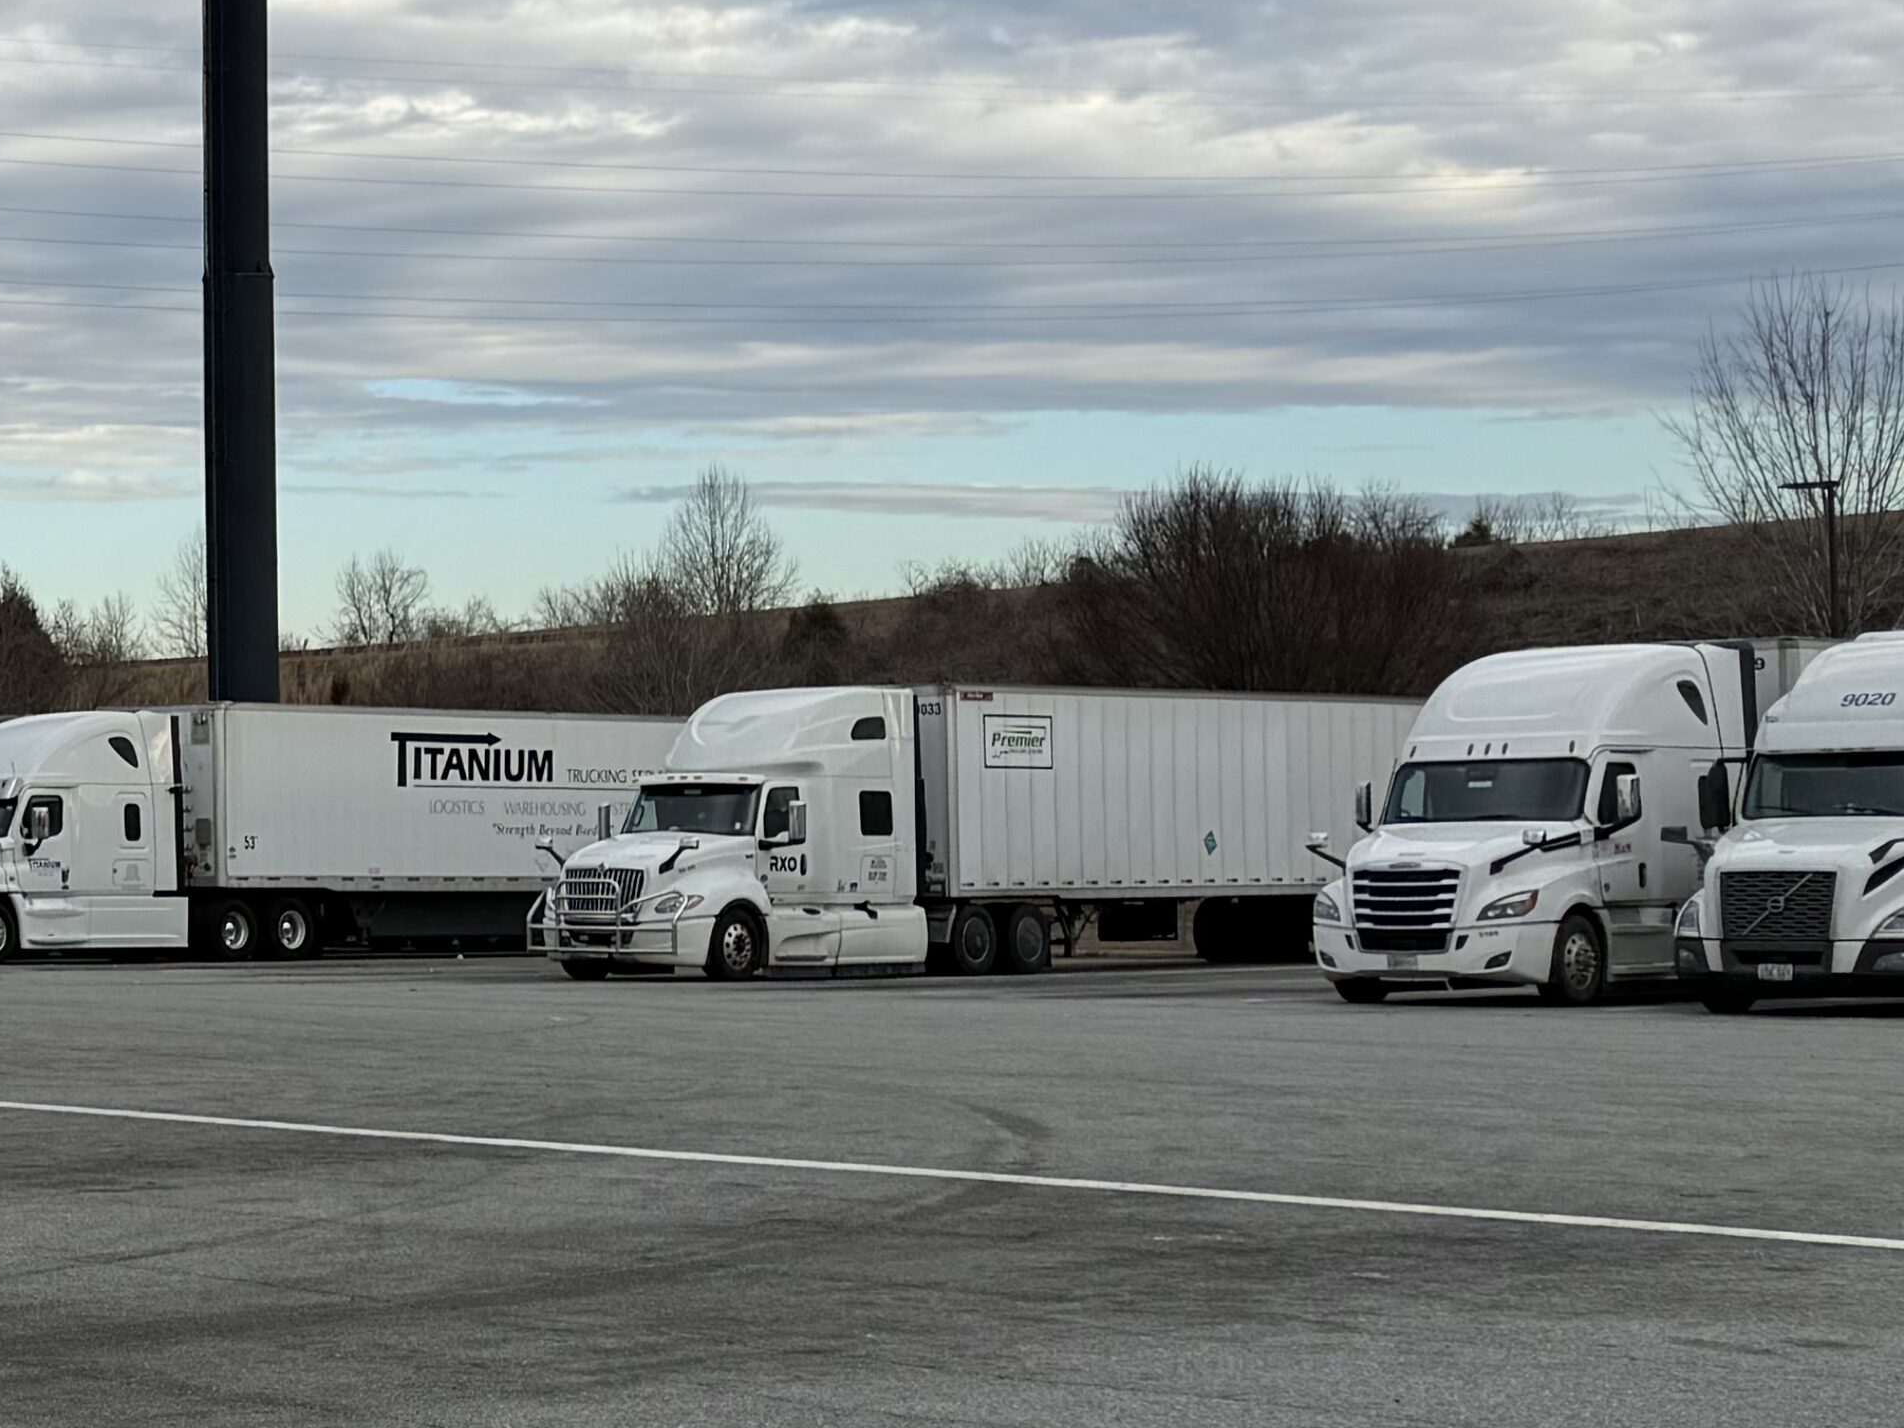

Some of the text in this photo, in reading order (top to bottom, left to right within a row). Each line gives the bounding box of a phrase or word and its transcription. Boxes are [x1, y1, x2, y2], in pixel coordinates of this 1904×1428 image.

[1840, 692, 1897, 707] 9020
[992, 732, 1045, 748] Premier
[391, 732, 553, 787] TITANIUM
[567, 768, 627, 783] TRUCKING
[429, 799, 485, 814] LOGISTICS
[769, 856, 798, 872] RXO
